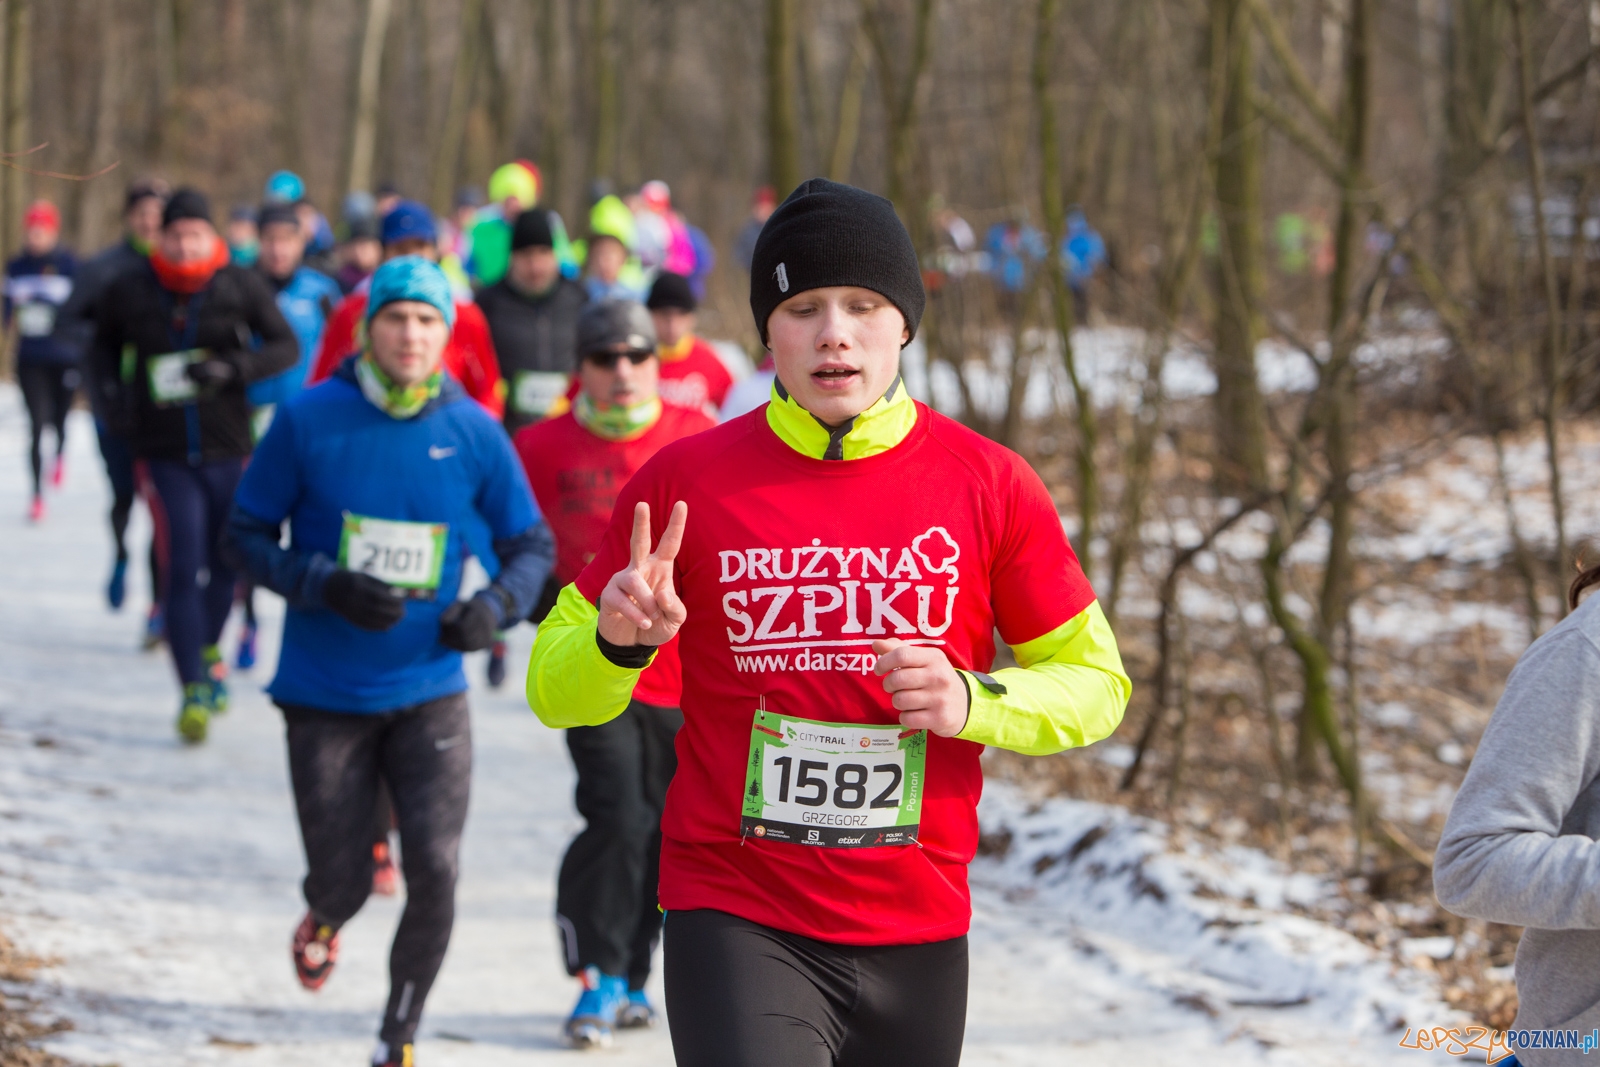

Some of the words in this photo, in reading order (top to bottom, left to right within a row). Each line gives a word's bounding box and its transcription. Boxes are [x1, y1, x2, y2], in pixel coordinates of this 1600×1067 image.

[361, 542, 424, 573] 2101
[718, 538, 922, 583] DRUŻYNA
[722, 580, 959, 643] SZPIKU
[734, 647, 882, 675] www.darszp
[773, 755, 903, 809] 1582
[906, 771, 919, 812] Poznań
[802, 811, 868, 827] GRZEGORZ
